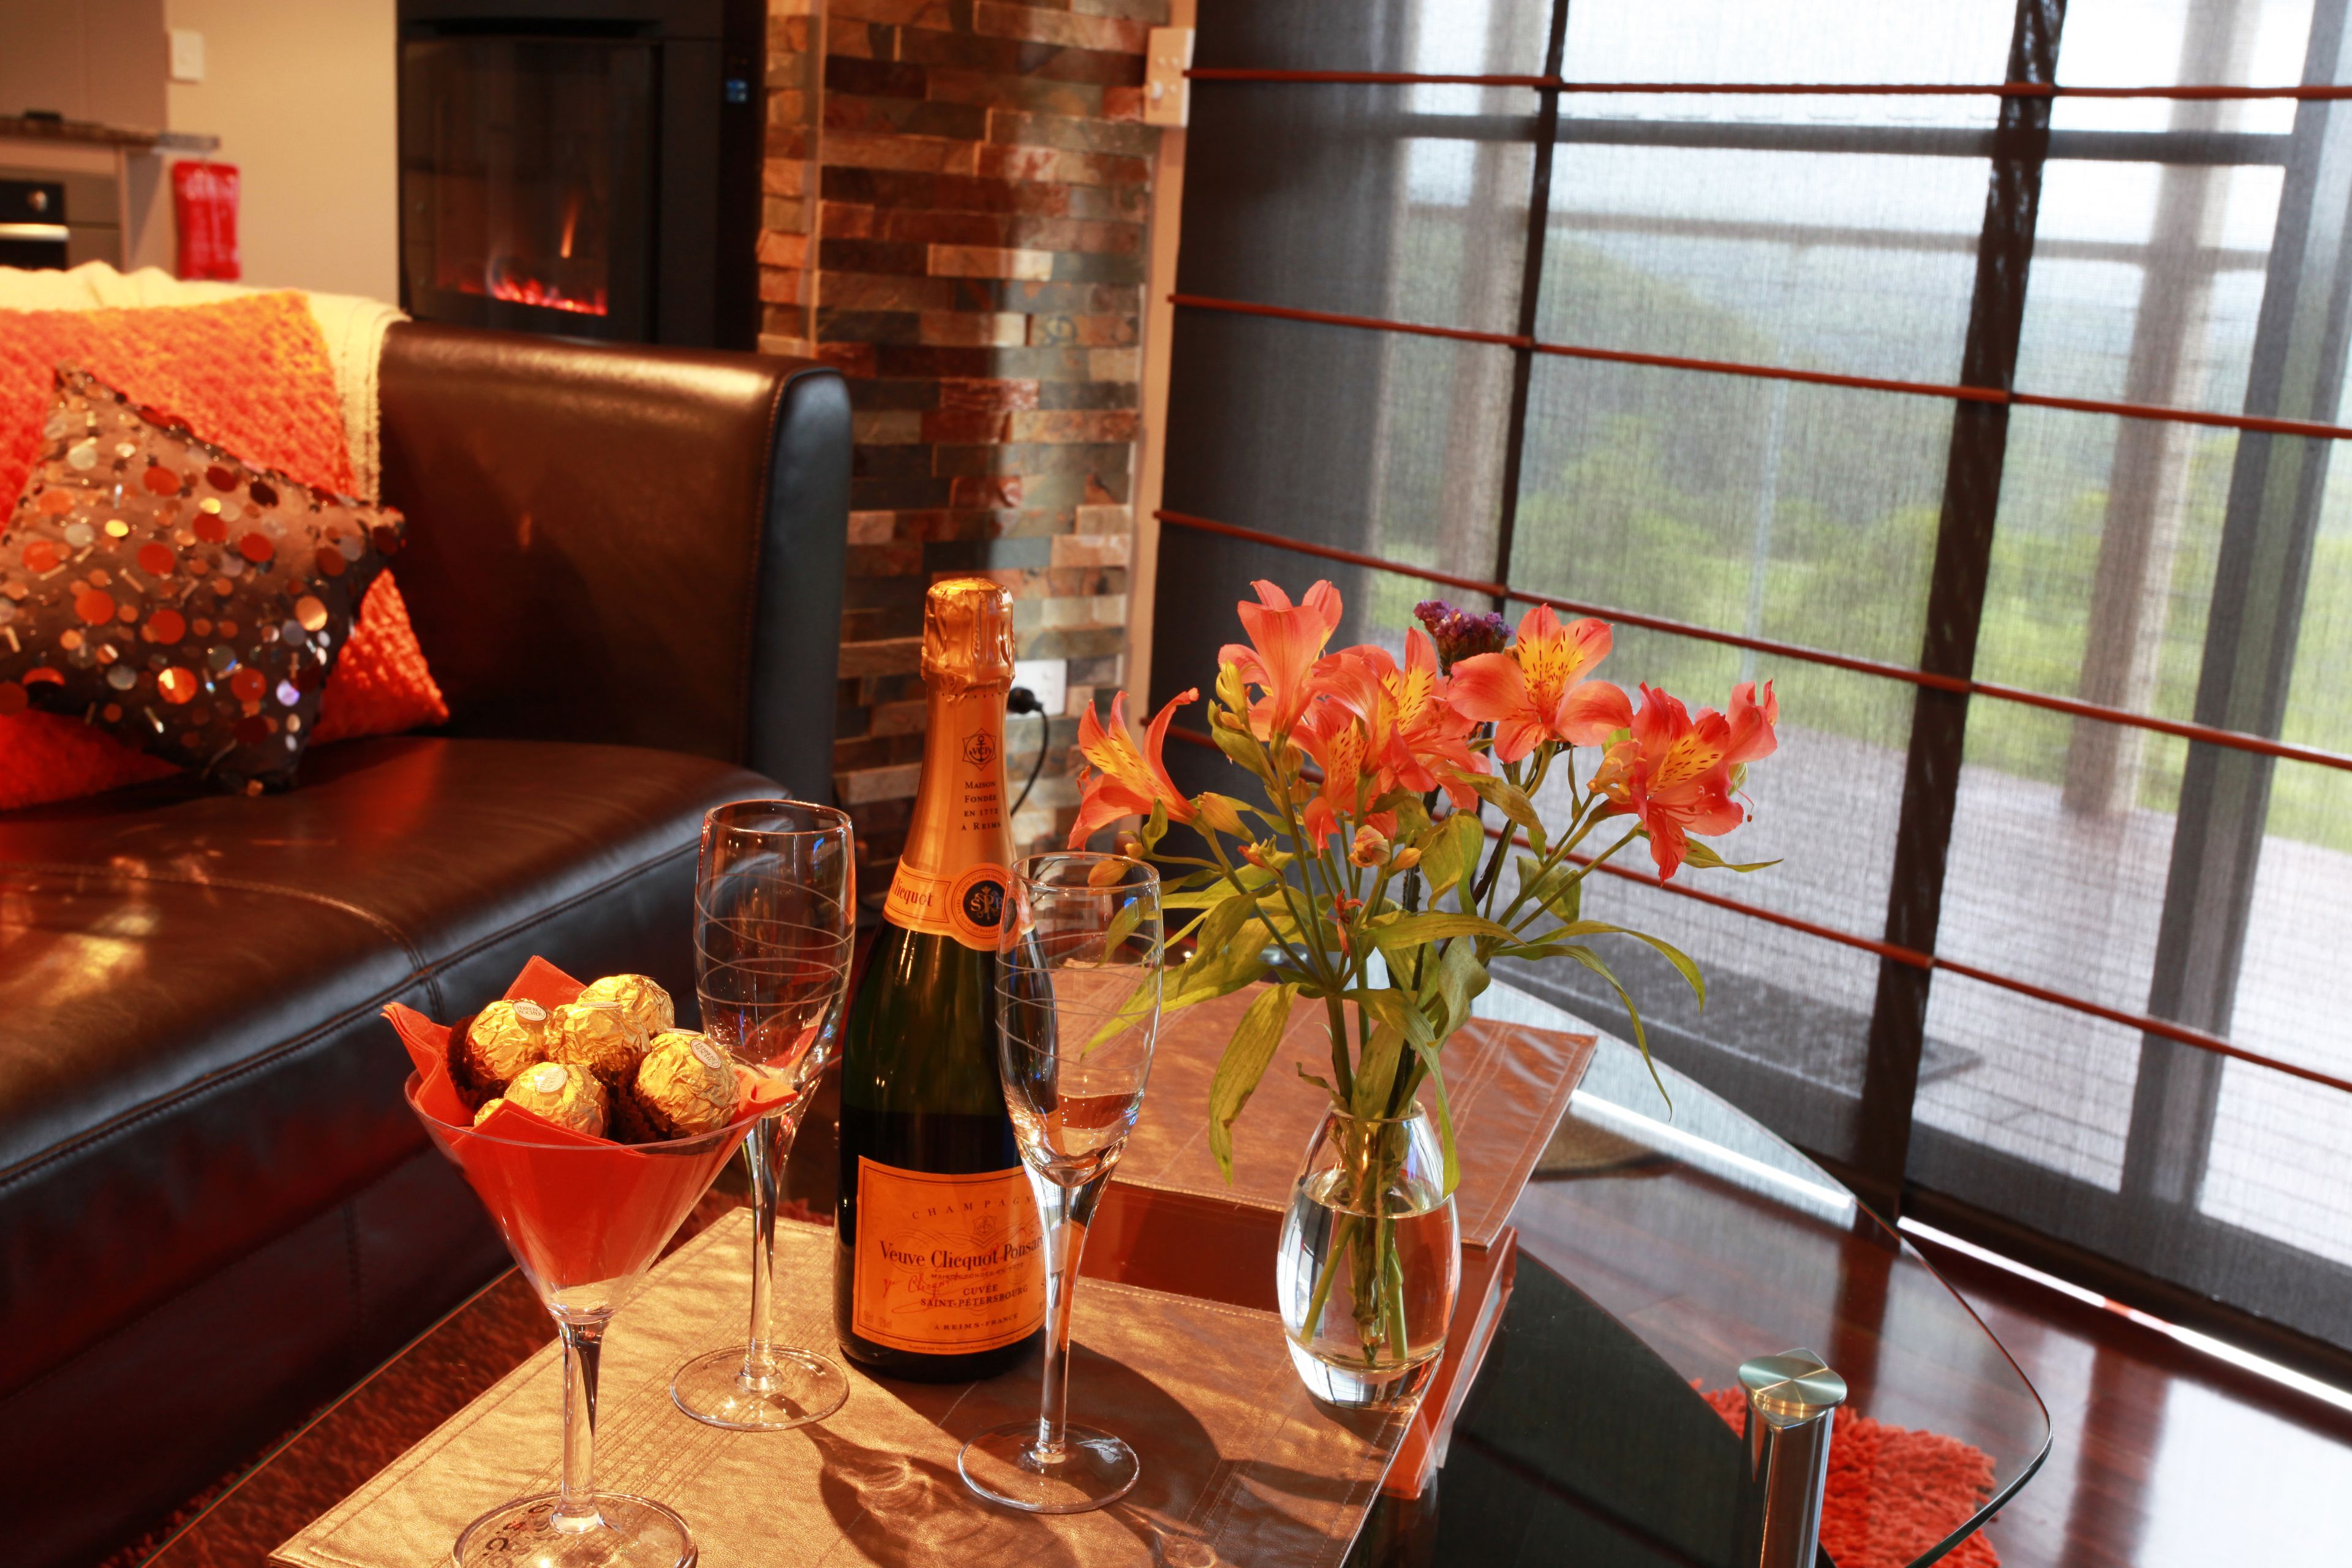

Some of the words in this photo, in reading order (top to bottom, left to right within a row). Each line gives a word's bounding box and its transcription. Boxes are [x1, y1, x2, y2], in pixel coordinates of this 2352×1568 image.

[980, 807, 998, 816] 1772
[973, 822, 1001, 831] REIMS
[912, 1196, 1033, 1220] CHAMPAGN
[878, 1240, 925, 1266] Veuve
[931, 1250, 998, 1271] Clicquot
[921, 1284, 1028, 1307] SAINT-PÉTERSBOURG
[963, 1283, 999, 1296] CUVÉE
